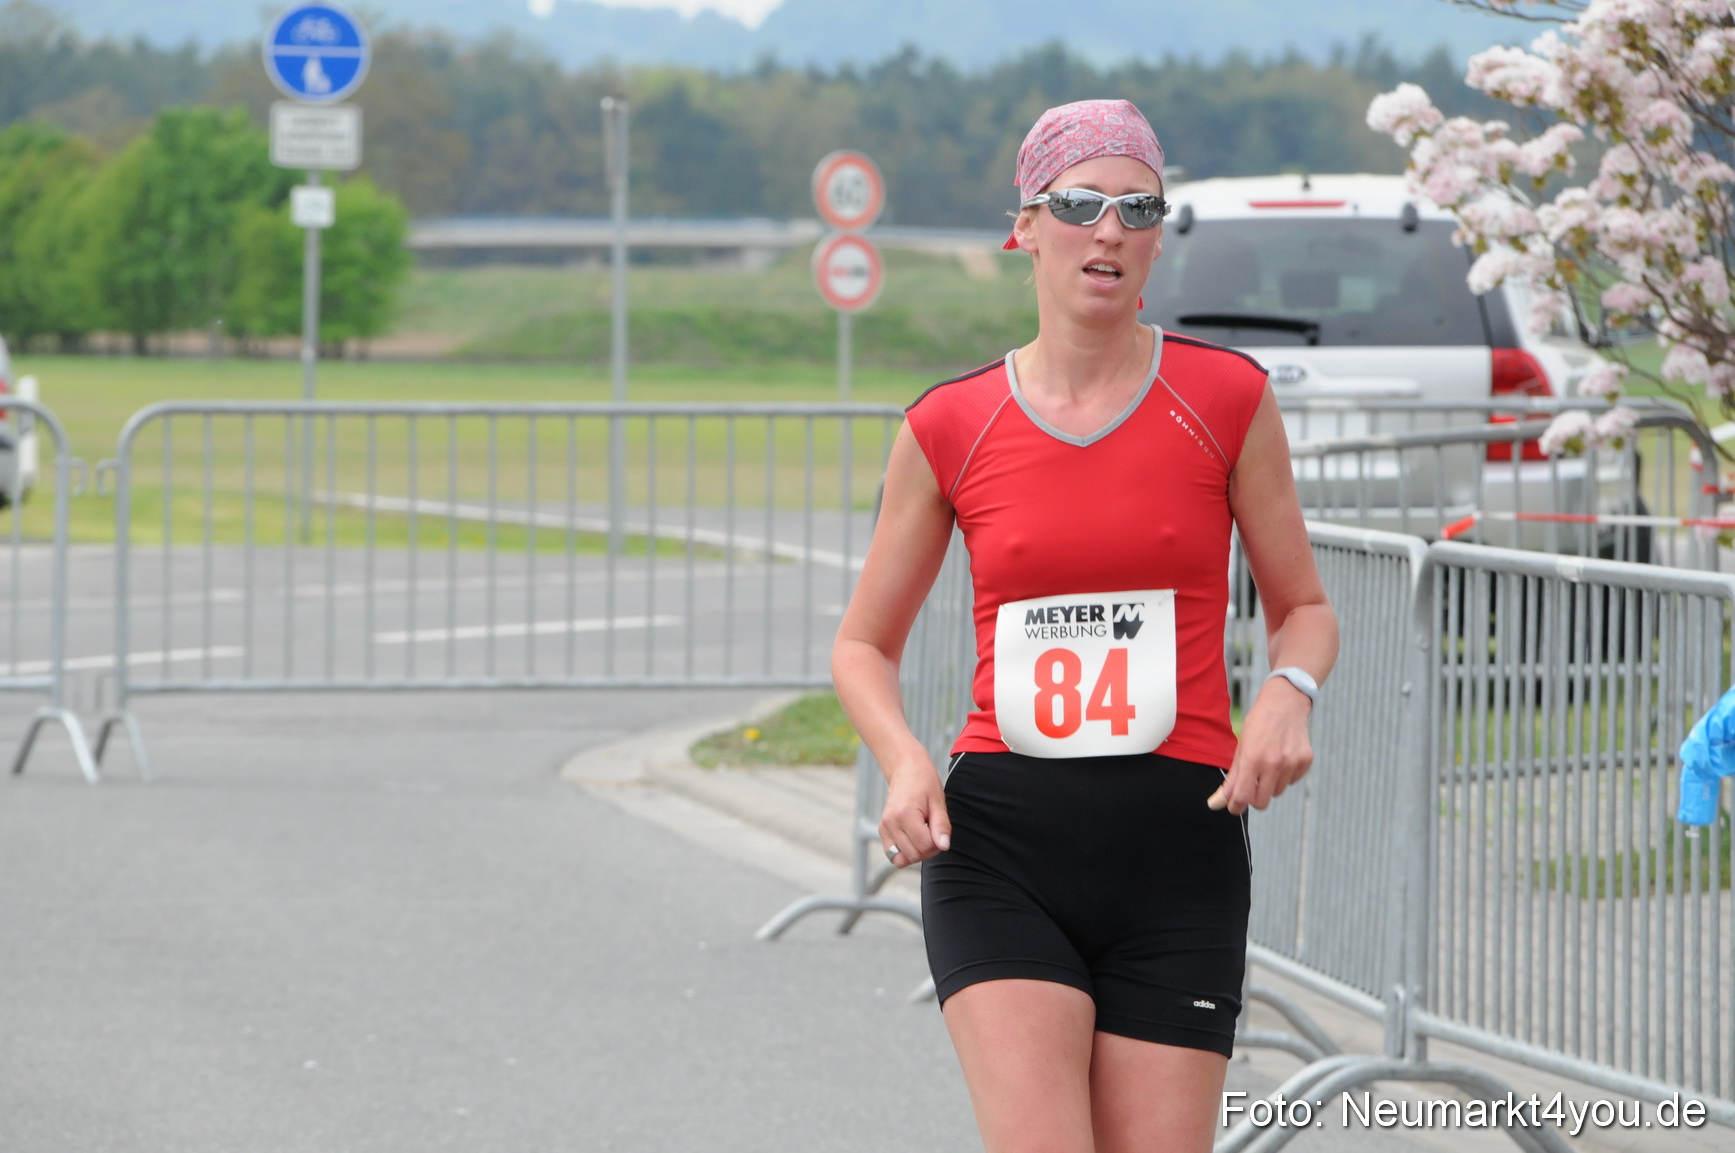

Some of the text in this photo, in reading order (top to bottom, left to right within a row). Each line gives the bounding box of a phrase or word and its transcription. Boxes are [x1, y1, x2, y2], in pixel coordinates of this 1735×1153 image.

[1024, 604, 1106, 626] MEYER
[1024, 624, 1107, 640] WERBUNG
[1033, 647, 1136, 739] 84
[1193, 1000, 1216, 1010] adidas
